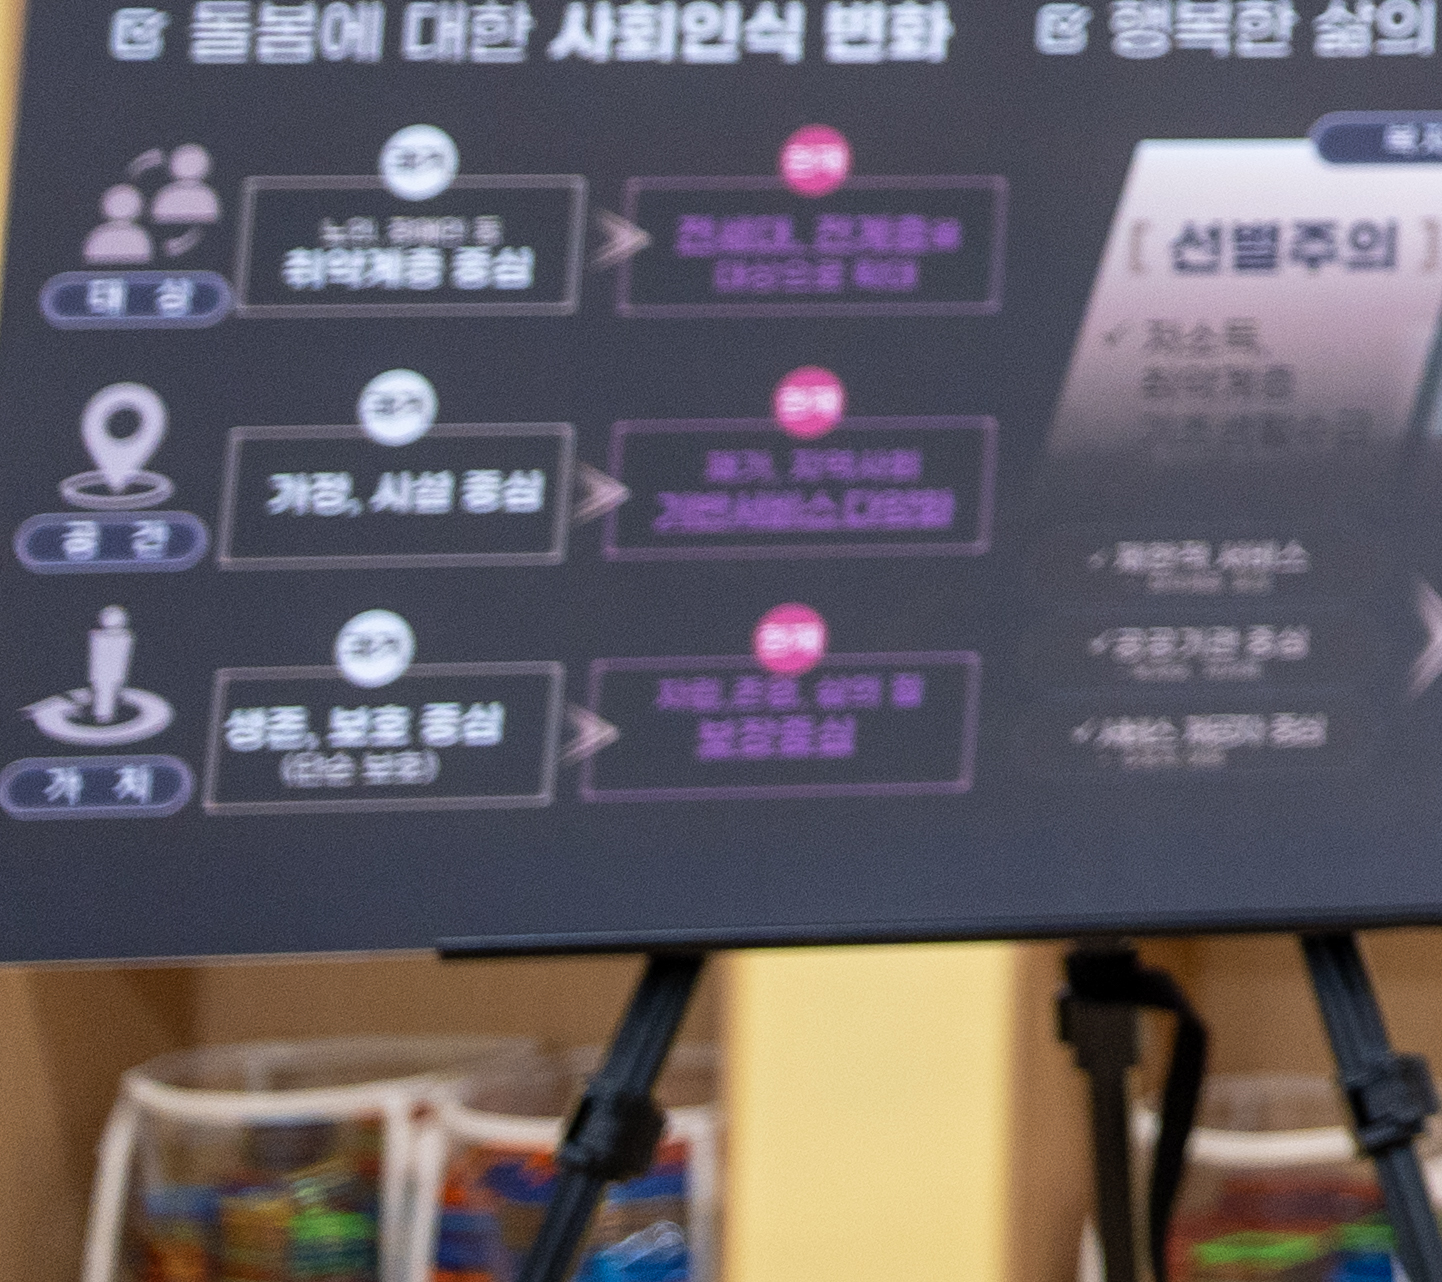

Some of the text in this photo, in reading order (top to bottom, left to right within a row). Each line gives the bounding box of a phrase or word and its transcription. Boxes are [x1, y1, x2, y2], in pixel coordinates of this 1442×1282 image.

[190, 0, 954, 65] 돌봄에 대한 사회인식 변화
[1170, 218, 1399, 275] 선별주의
[461, 468, 547, 515] 중심
[420, 701, 504, 748] 중심
